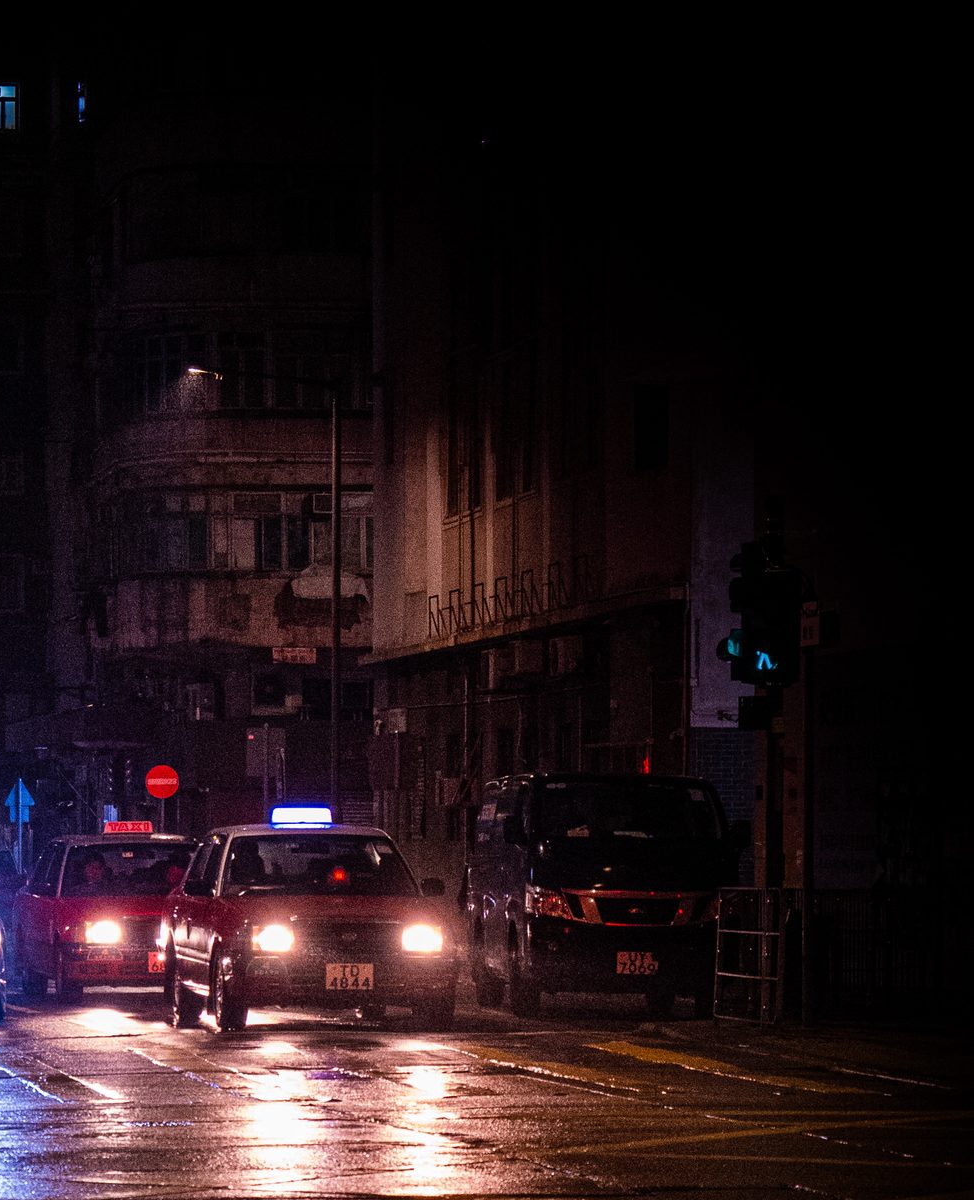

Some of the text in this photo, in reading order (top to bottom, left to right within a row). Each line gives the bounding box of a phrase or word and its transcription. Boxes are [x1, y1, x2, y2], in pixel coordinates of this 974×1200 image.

[108, 822, 150, 832] TAXI
[339, 964, 360, 977] TD
[328, 976, 371, 991] 4844
